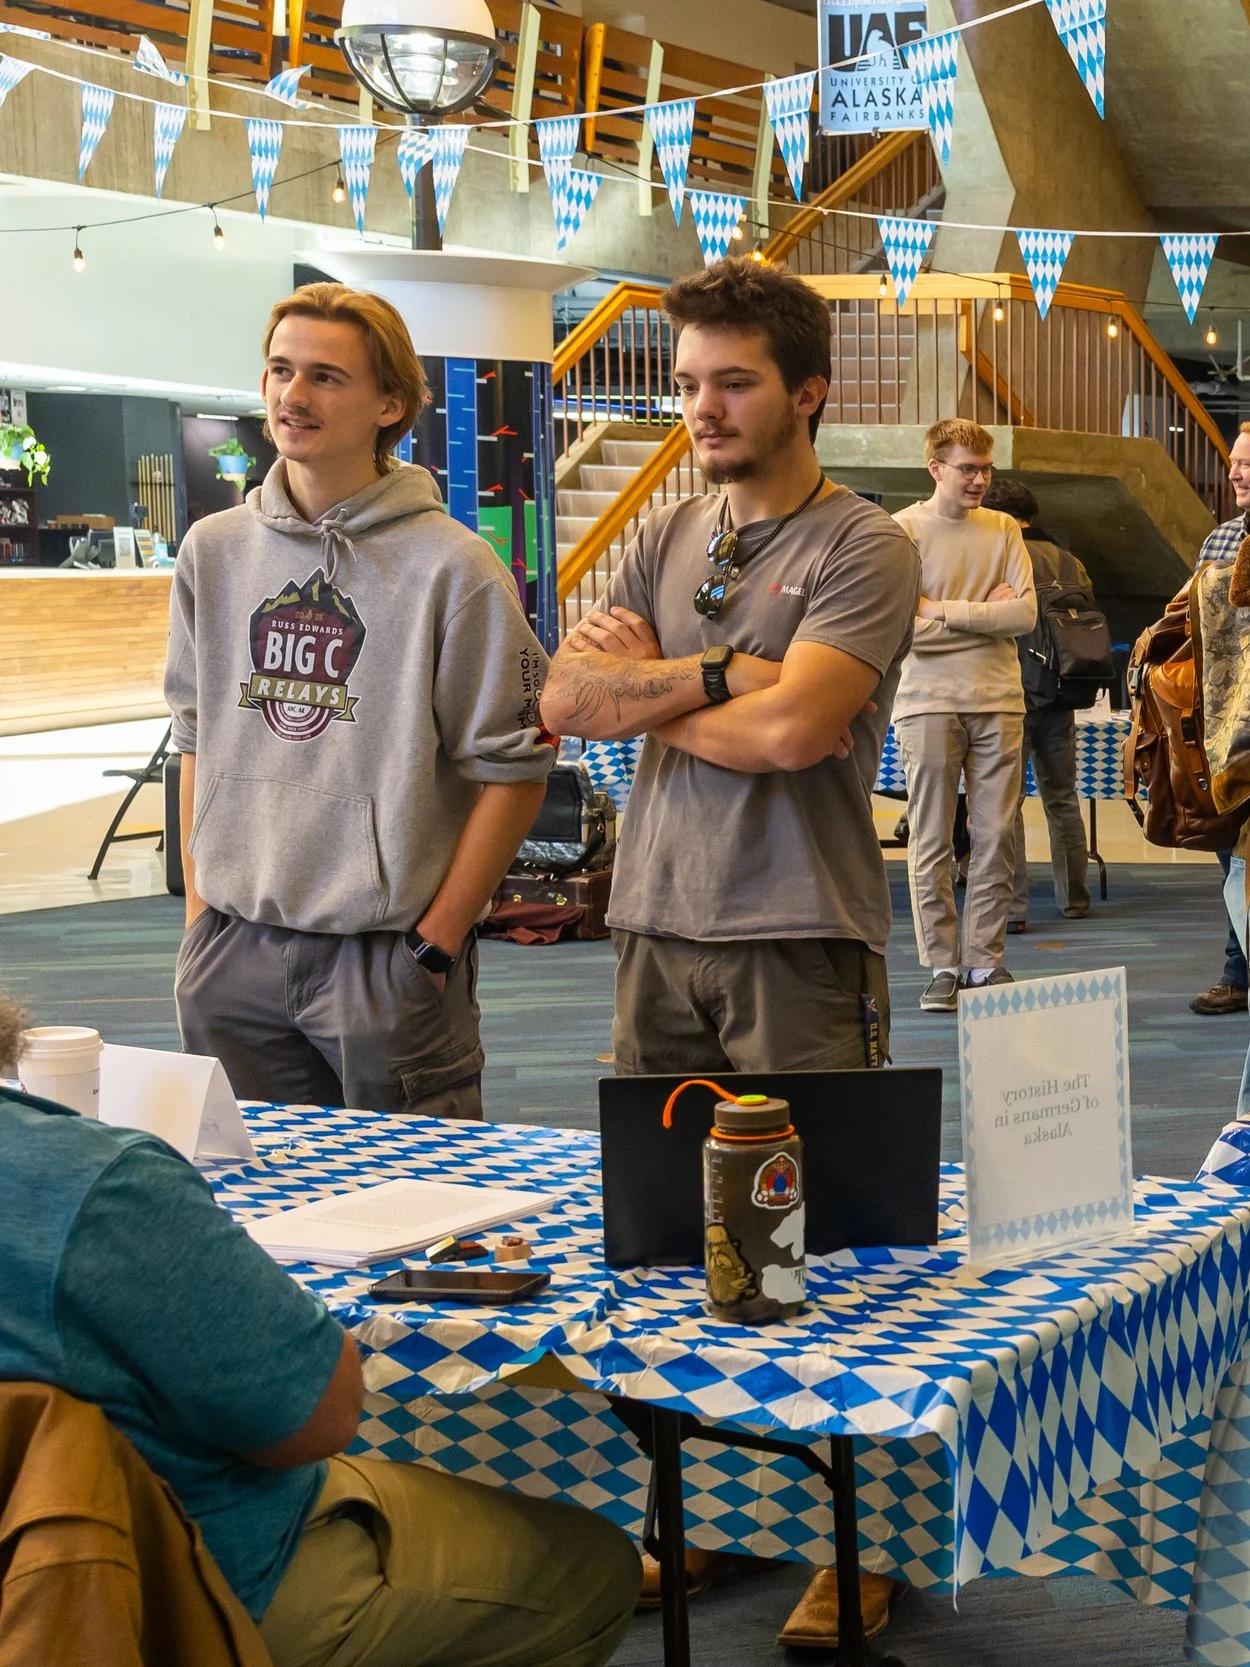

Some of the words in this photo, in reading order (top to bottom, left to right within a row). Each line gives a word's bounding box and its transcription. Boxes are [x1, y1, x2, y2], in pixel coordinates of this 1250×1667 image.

[828, 11, 927, 72] UAF
[830, 76, 905, 87] UNIVERSITY
[831, 87, 922, 108] ALASKA
[830, 109, 925, 122] FAIRBANKS
[272, 620, 296, 630] RUSS
[299, 624, 344, 635] EDWARDS
[264, 631, 316, 675] BIG
[324, 639, 344, 678] C
[520, 647, 532, 693] YOUR
[533, 672, 540, 687] SO
[257, 679, 341, 705] RELAYS
